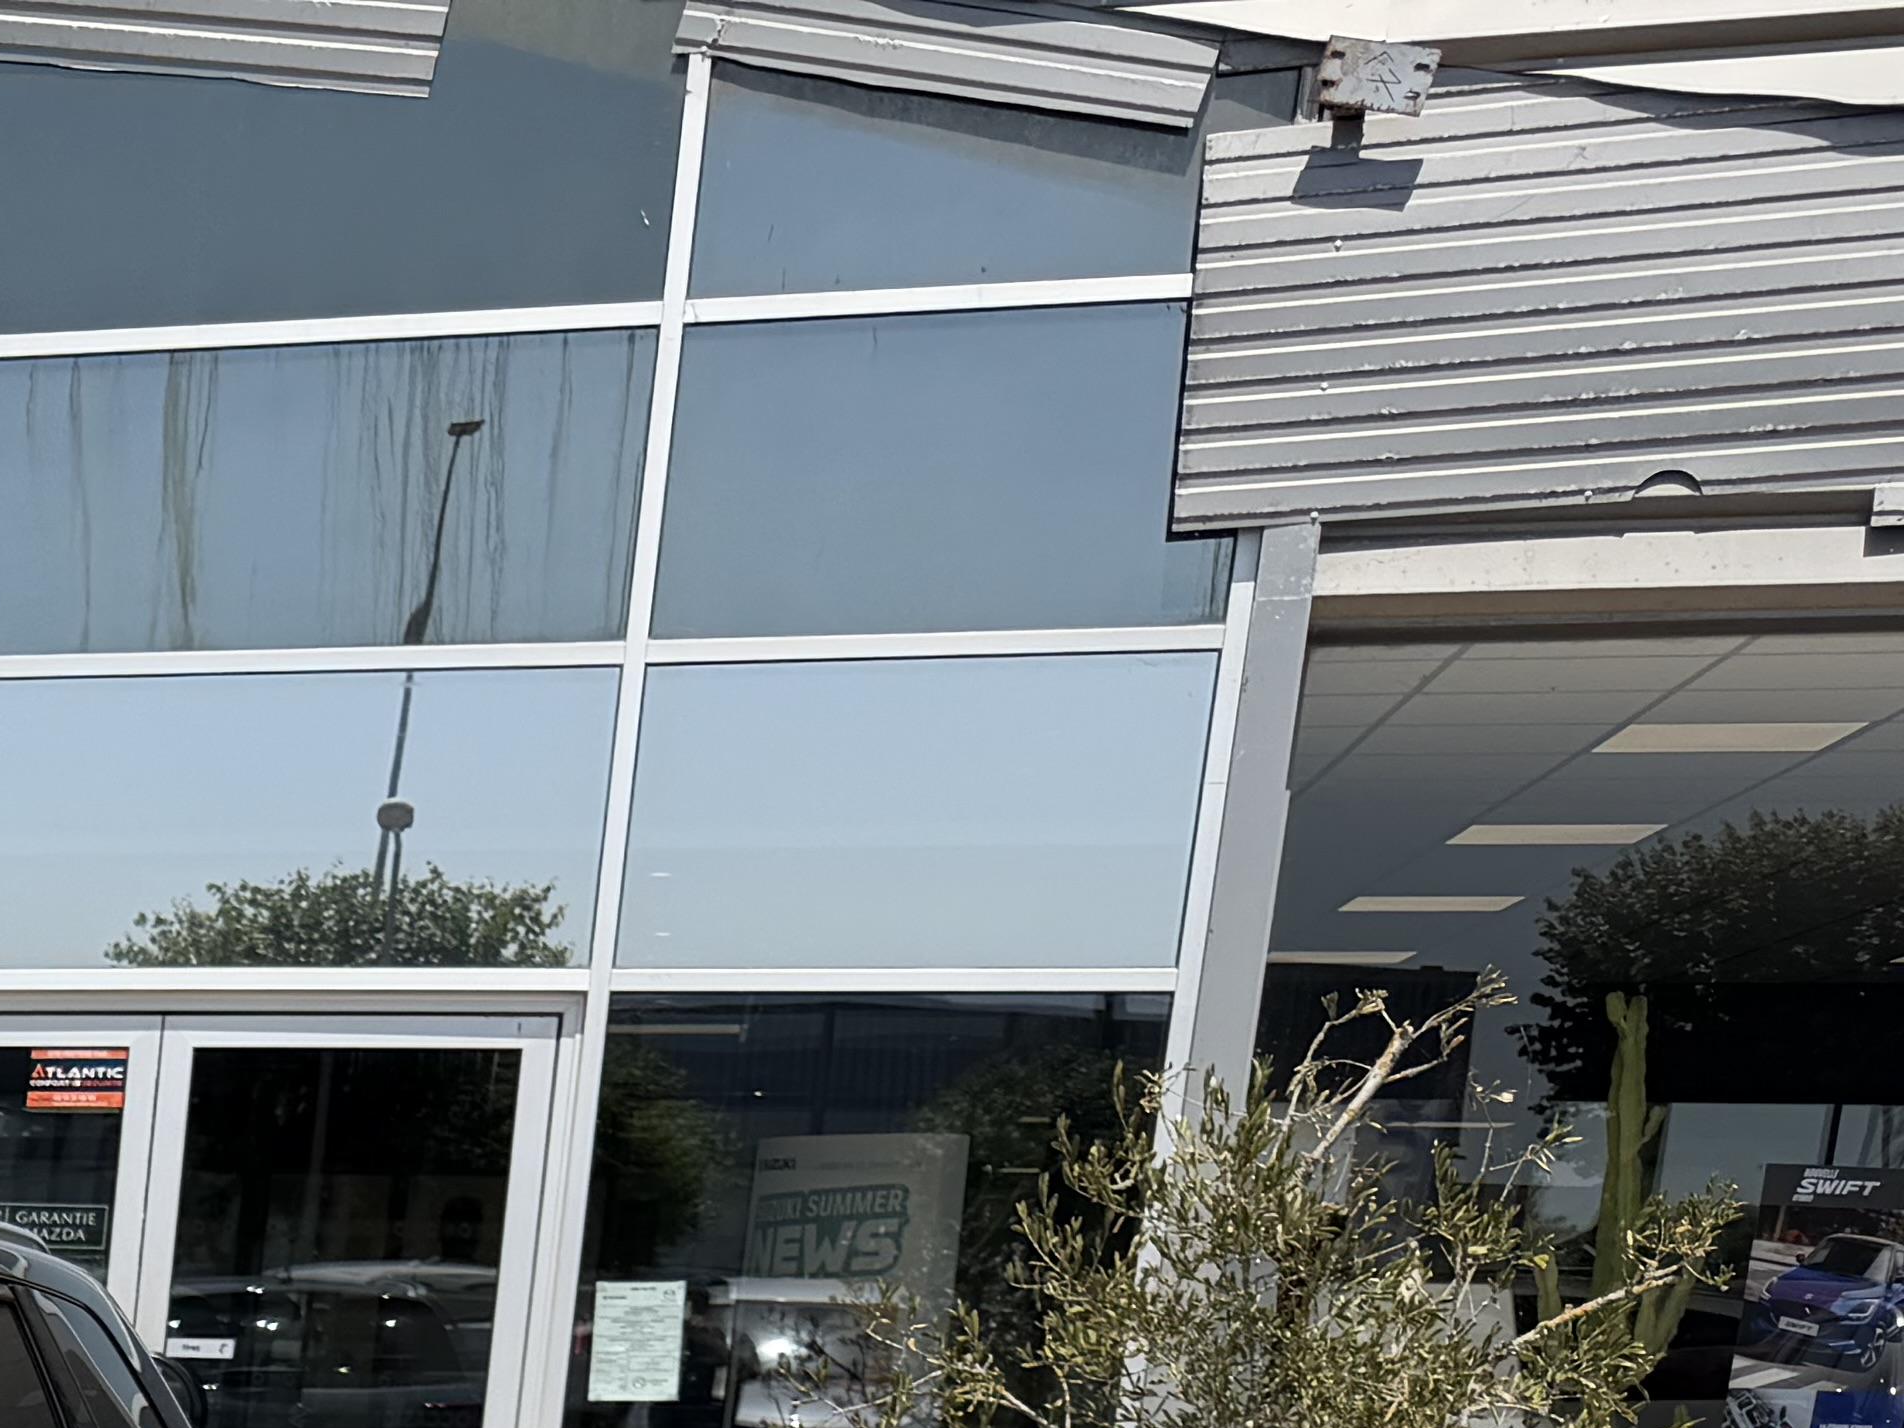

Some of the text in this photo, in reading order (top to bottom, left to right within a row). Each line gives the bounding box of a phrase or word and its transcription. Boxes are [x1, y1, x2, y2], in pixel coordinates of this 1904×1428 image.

[31, 1063, 124, 1079] ATLANTIC
[1796, 1178, 1881, 1197] SWIFT
[806, 1188, 904, 1217] SUMMER
[15, 1210, 97, 1226] GARANTIE
[746, 1219, 901, 1276] NEWS
